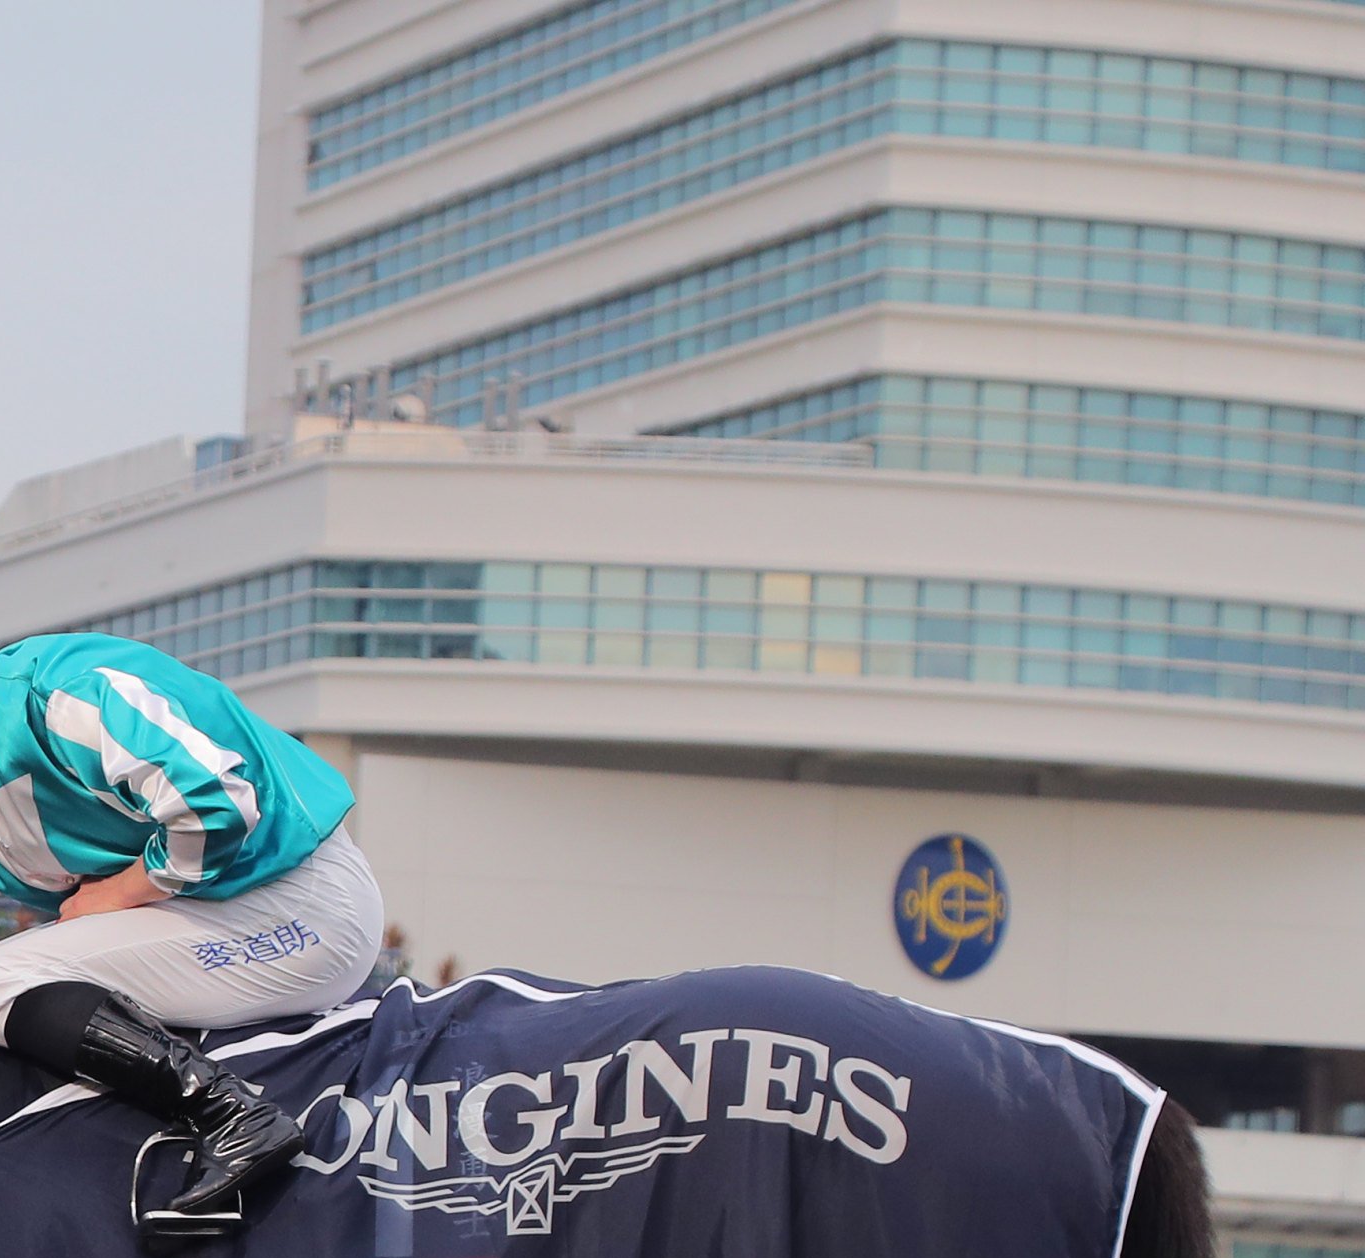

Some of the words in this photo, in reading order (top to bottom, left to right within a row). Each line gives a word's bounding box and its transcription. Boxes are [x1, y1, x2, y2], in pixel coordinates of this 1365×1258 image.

[190, 918, 320, 971] 麥道朗
[183, 1028, 911, 1174] ONGINES
